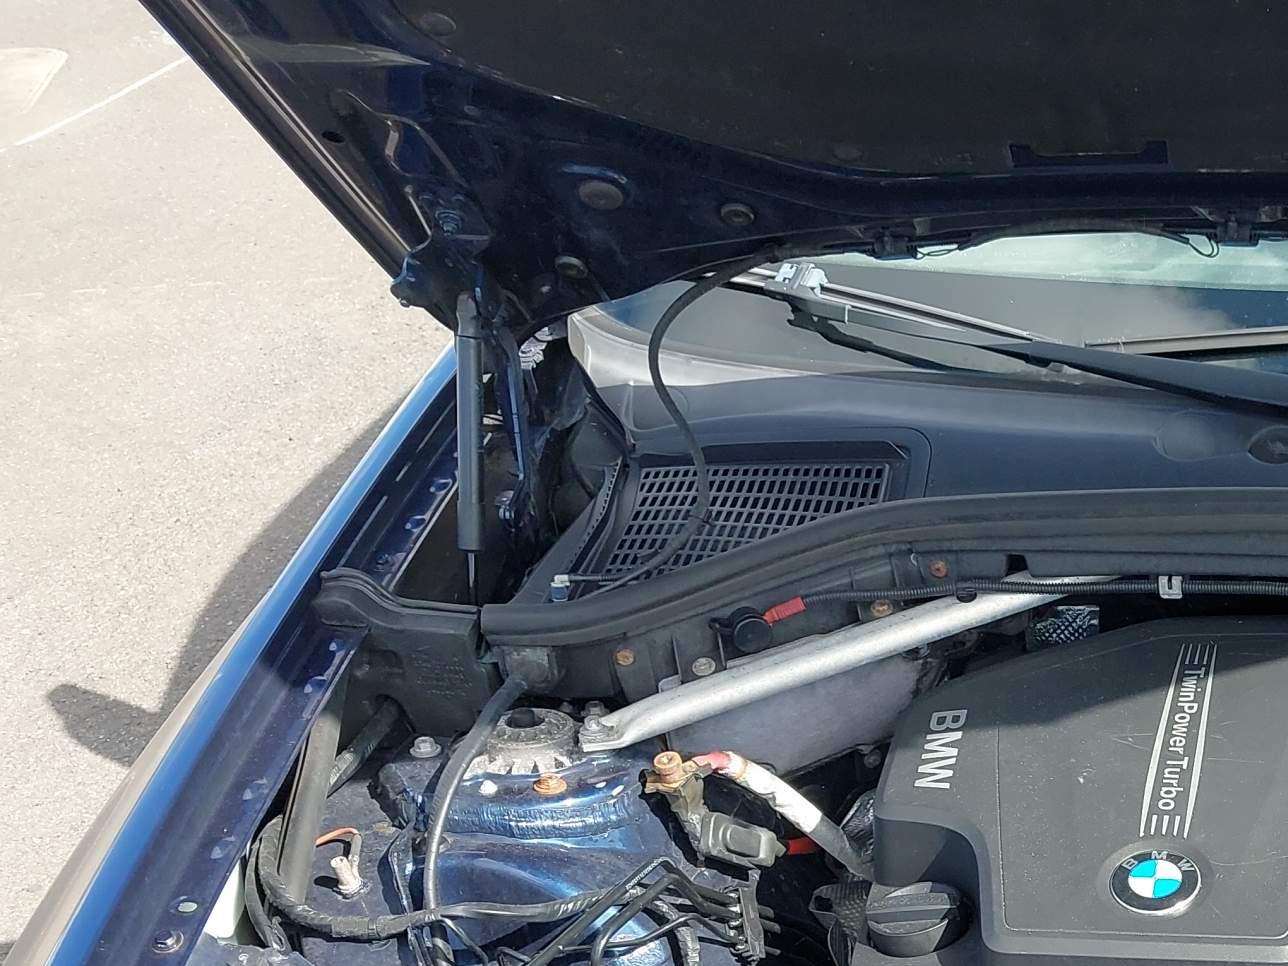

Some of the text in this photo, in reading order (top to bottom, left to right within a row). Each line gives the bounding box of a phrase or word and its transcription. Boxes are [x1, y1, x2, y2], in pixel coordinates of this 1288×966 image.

[914, 709, 968, 789] BMW
[1158, 667, 1206, 810] TwinPower Turbo
[1120, 850, 1195, 871] BMW
